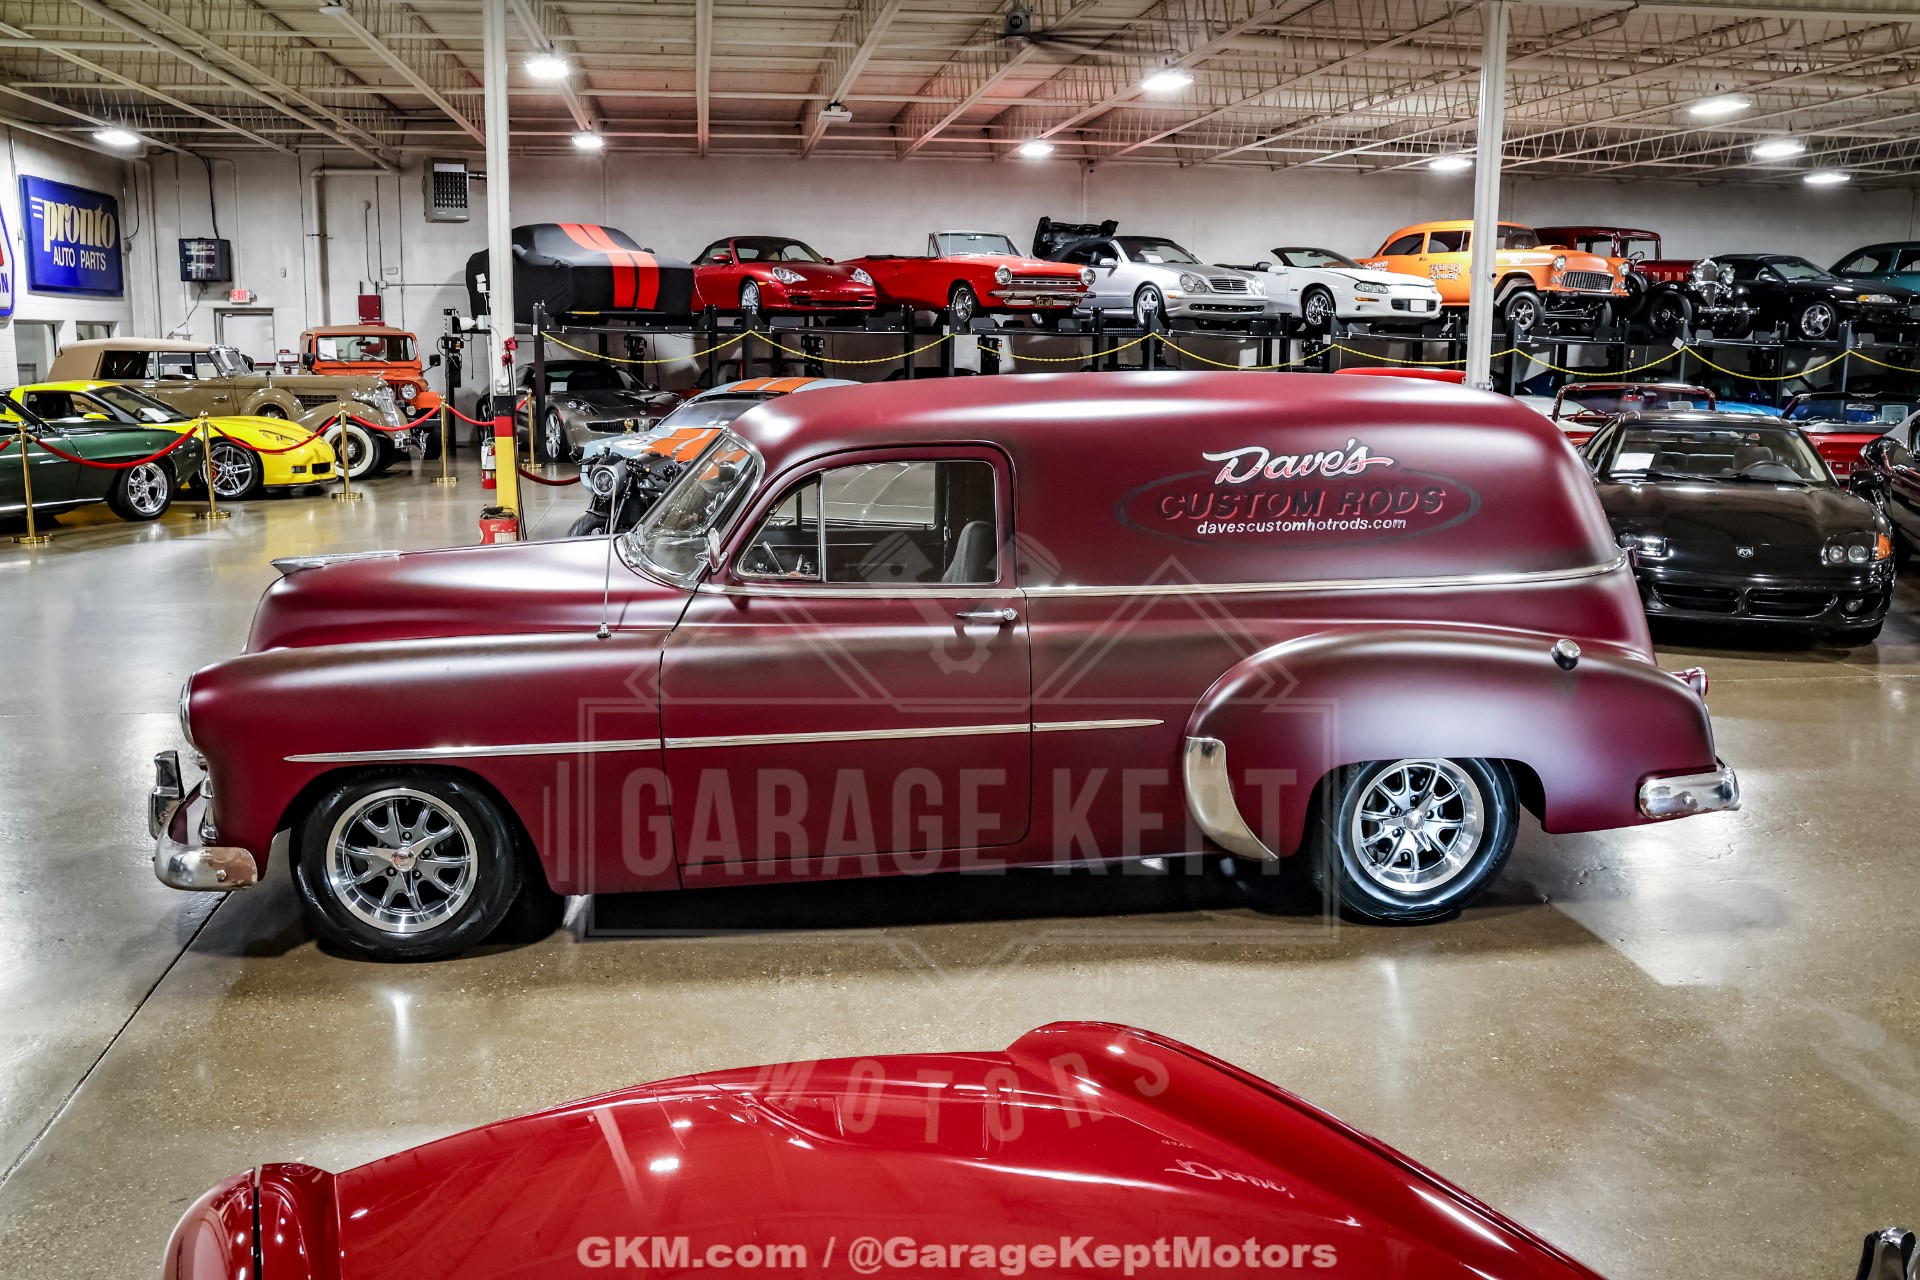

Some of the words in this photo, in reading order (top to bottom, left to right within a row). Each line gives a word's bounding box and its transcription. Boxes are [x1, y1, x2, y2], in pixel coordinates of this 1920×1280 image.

[42, 198, 116, 252] pronto
[53, 246, 76, 268] AUTO
[80, 250, 107, 271] PARTS
[232, 289, 247, 301] EXIT
[1202, 438, 1395, 486] Dave's
[1158, 489, 1327, 521] CUSTOM
[1336, 486, 1447, 516] RODS
[1197, 517, 1407, 535] davescustomhotrods.com
